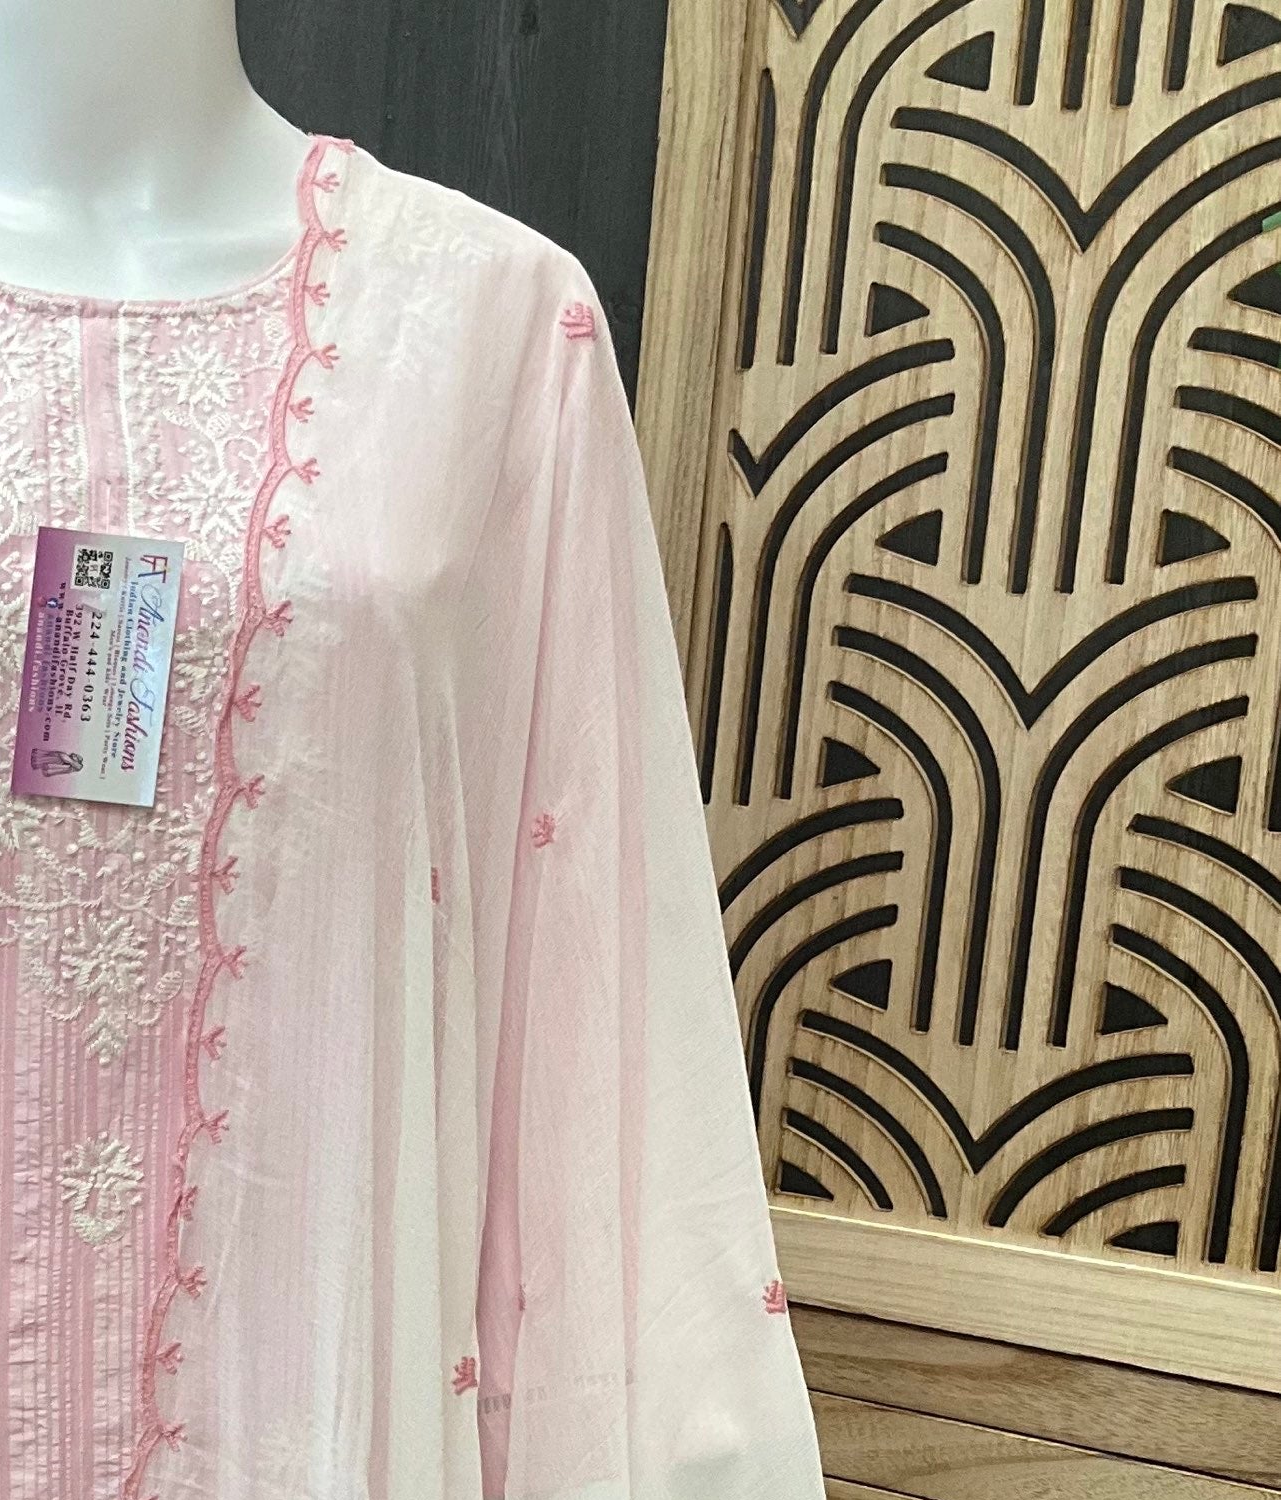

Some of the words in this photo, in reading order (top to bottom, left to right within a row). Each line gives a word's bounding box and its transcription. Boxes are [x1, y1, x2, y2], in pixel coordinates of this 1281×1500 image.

[73, 604, 84, 626] 392
[127, 581, 139, 616] Indian
[61, 609, 75, 655] Buffalo
[72, 630, 81, 640] W
[119, 618, 135, 663] Clothing
[132, 584, 165, 675] Anandi
[68, 645, 79, 674] Half
[80, 611, 103, 723] 224-444-0363
[119, 665, 129, 685] and
[64, 676, 76, 699] Day
[112, 688, 126, 727] Jewelry
[120, 678, 155, 773] Fashions
[110, 731, 121, 759] Store
